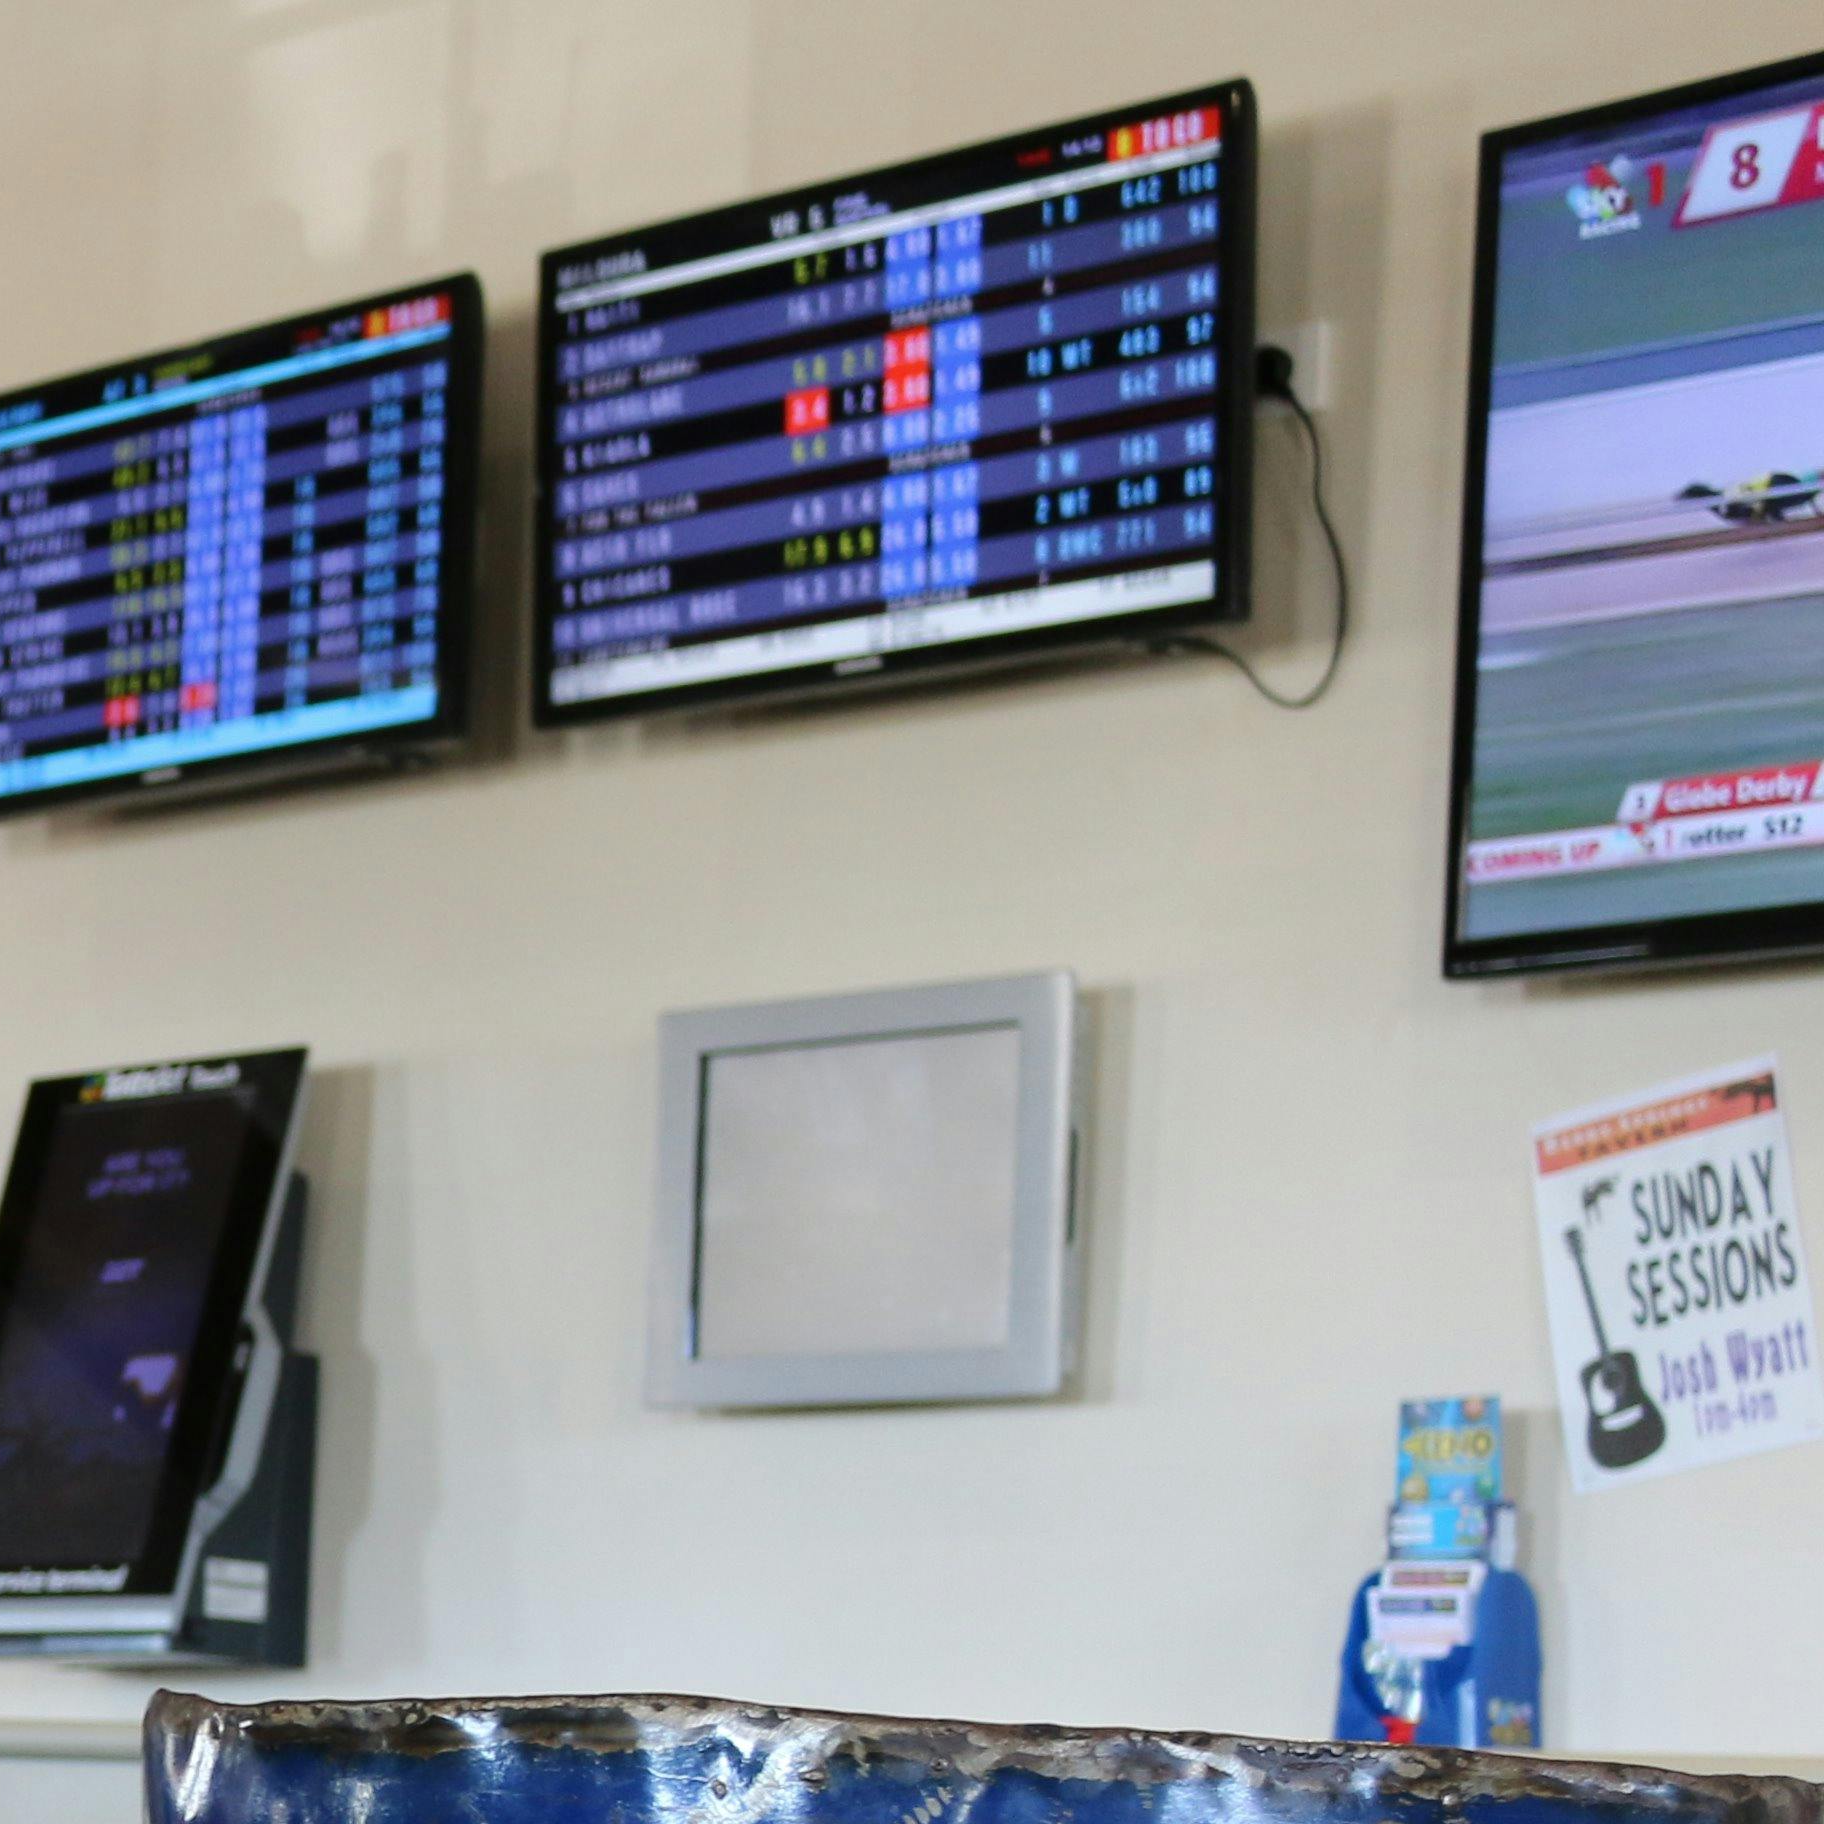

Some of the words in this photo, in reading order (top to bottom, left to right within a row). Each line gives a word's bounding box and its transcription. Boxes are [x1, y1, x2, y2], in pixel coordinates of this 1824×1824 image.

[1730, 144, 1760, 190] 8
[1630, 1148, 1774, 1245] SUNDAY
[1625, 1222, 1798, 1328] SESSIONS
